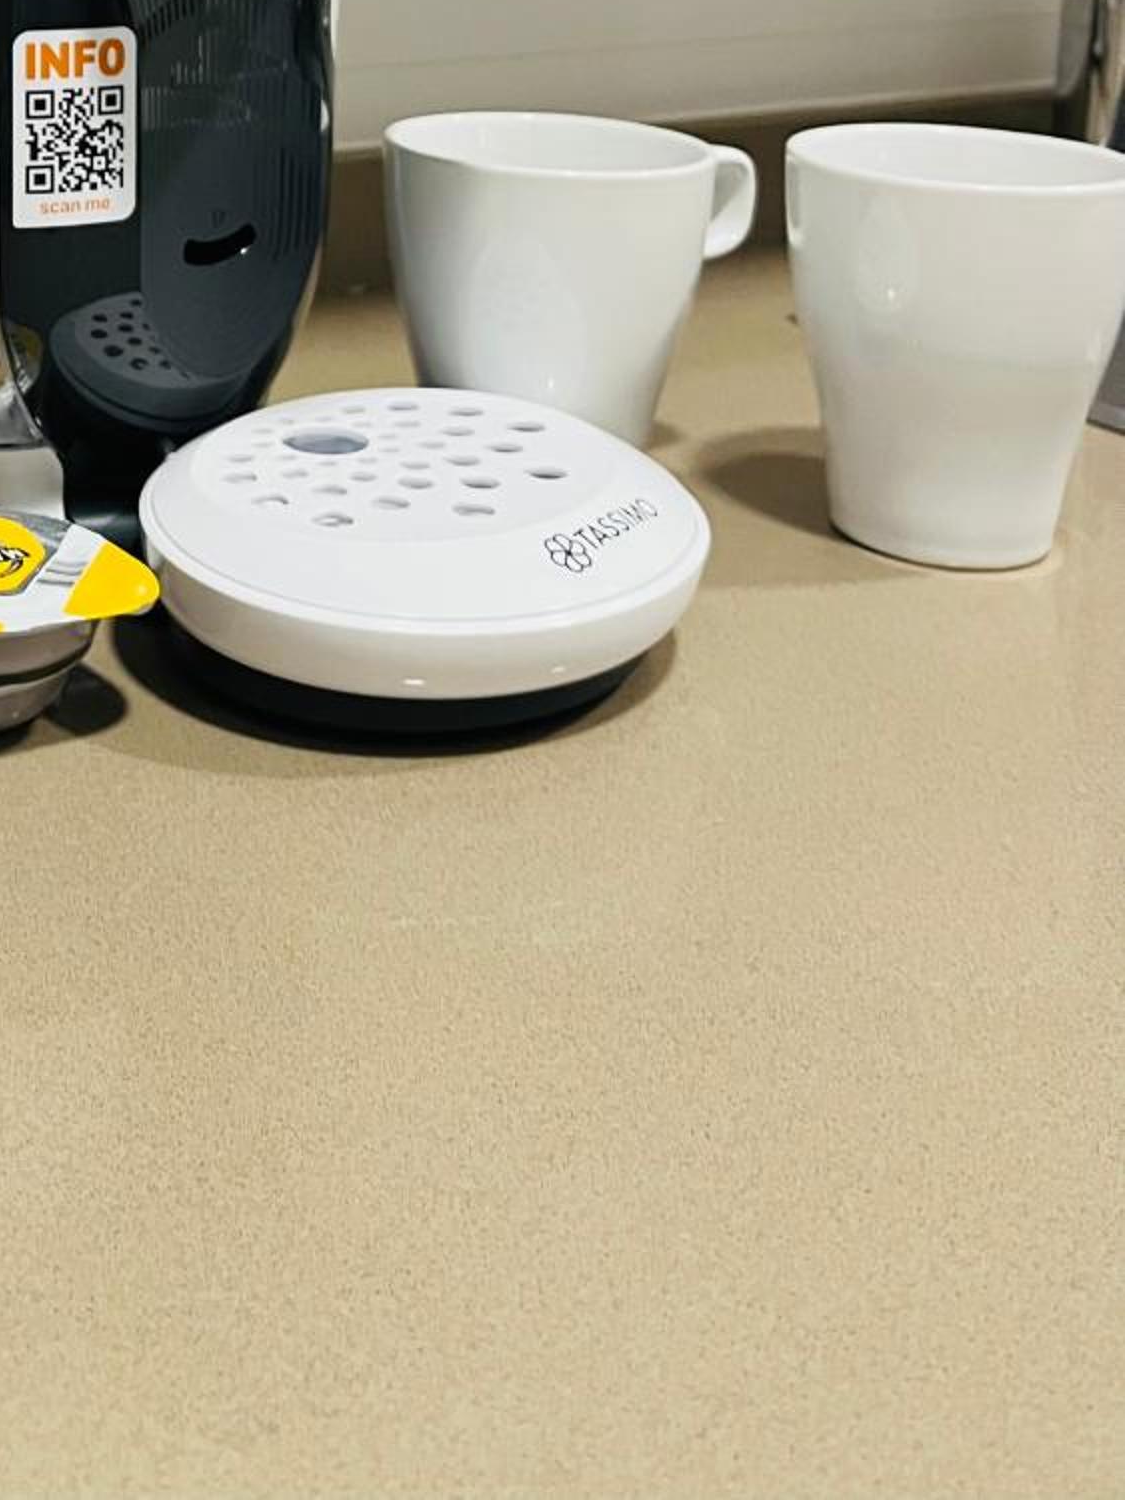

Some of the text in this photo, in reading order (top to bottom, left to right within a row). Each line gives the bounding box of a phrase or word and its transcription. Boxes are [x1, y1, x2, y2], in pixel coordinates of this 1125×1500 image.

[24, 37, 125, 80] INFO
[39, 198, 110, 215] scan me
[573, 498, 658, 549] TASSIMO
